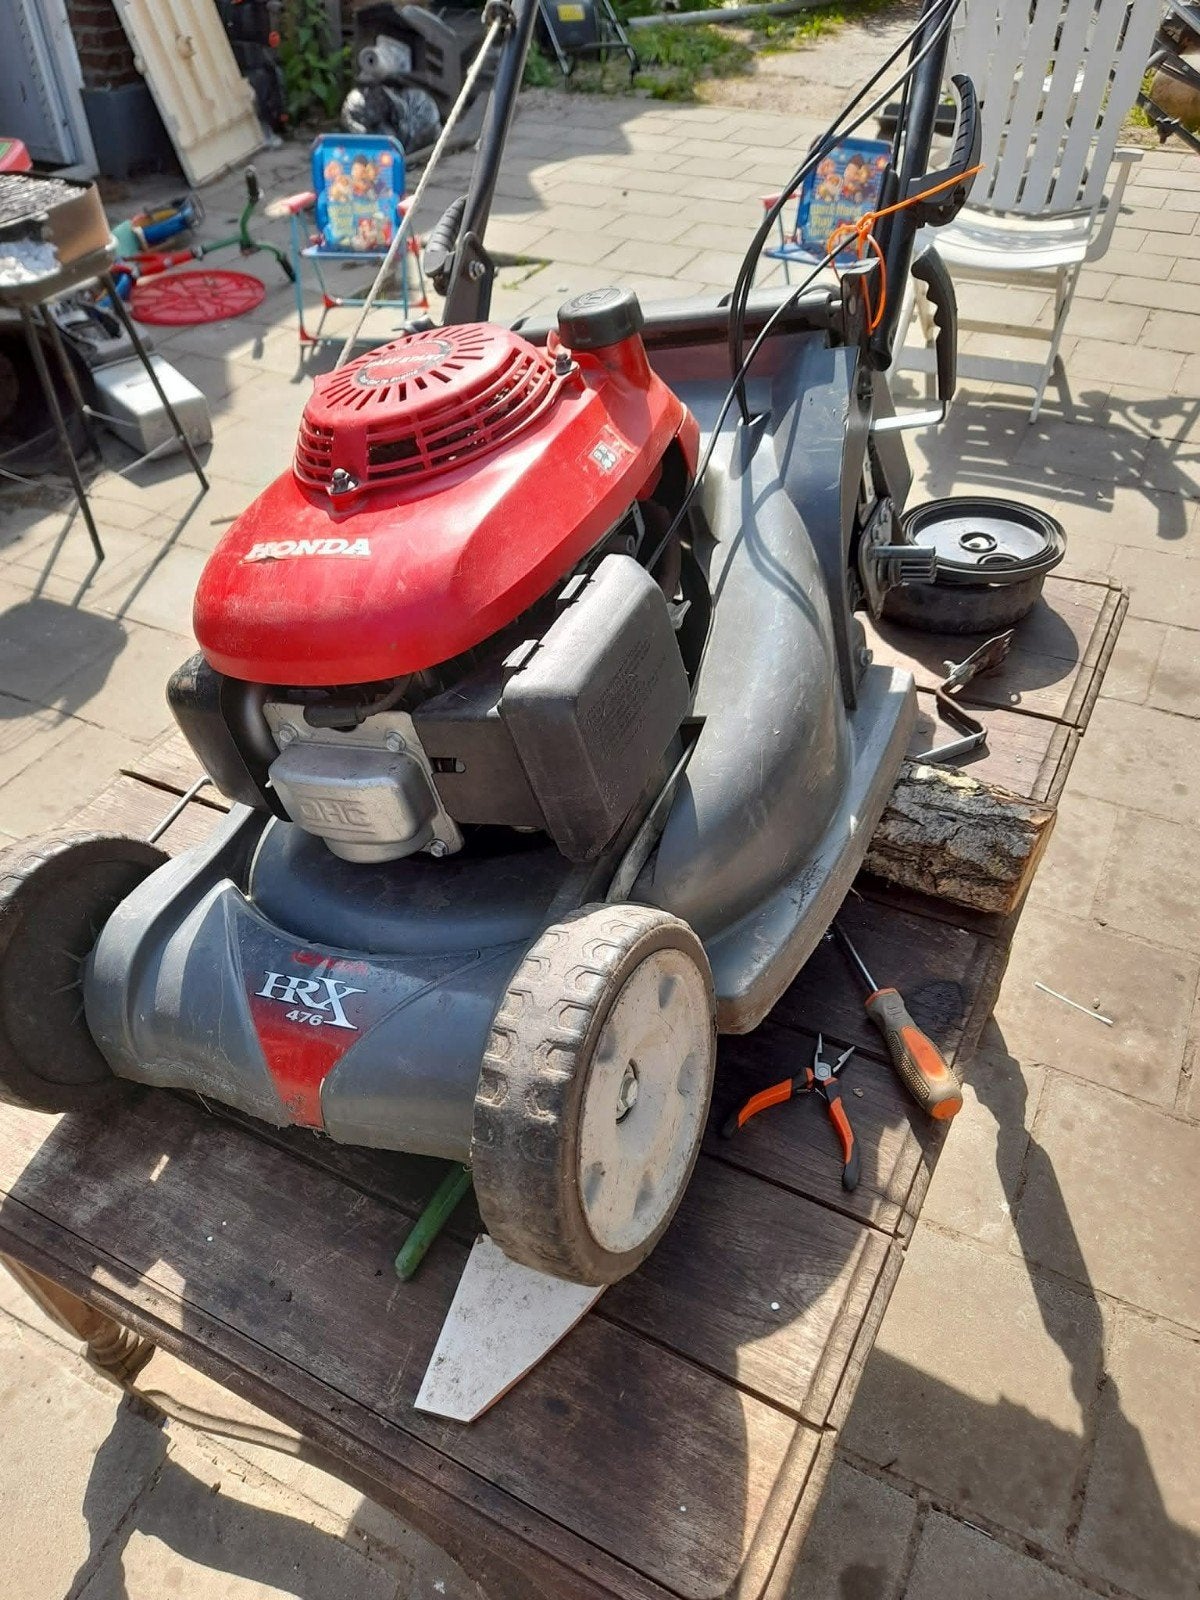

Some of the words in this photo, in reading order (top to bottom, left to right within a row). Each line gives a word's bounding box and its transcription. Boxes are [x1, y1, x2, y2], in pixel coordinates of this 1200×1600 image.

[244, 538, 371, 560] HONDA
[254, 970, 367, 1030] HRX
[285, 1009, 323, 1026] 476
